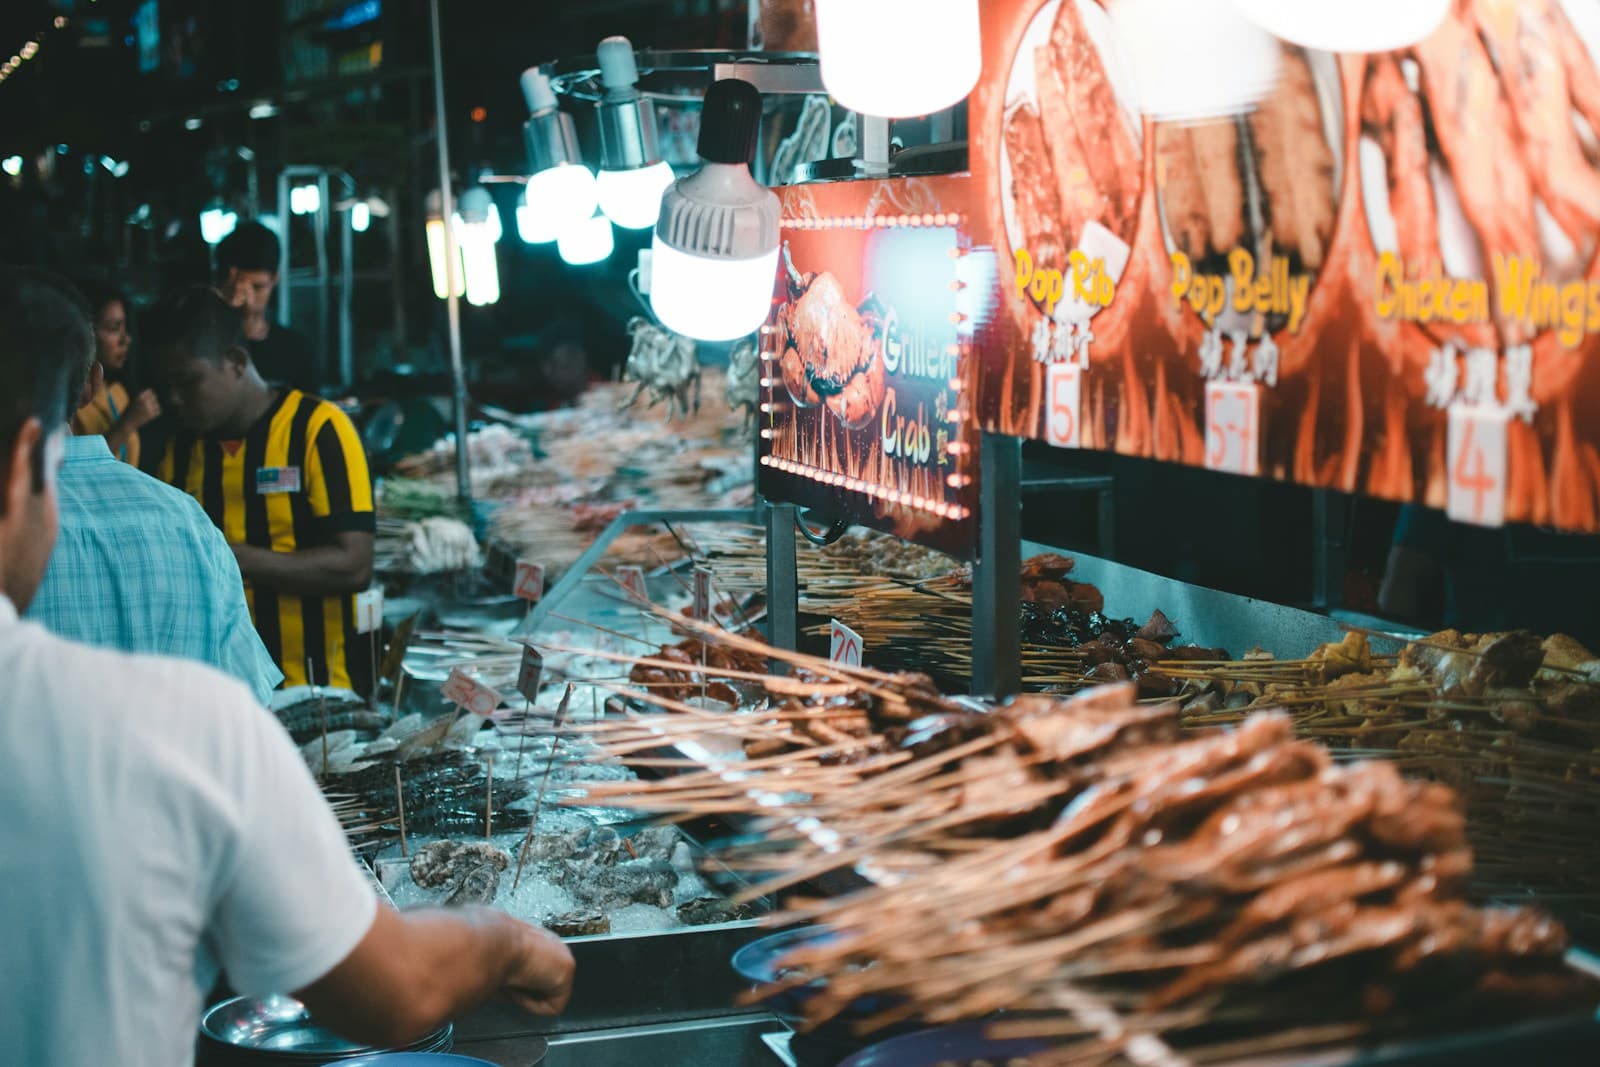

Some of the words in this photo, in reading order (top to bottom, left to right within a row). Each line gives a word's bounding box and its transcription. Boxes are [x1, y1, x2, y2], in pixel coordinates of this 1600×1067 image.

[1014, 248, 1063, 315] Pop
[1069, 249, 1115, 307] Rib
[1170, 251, 1225, 328] Pop
[1228, 247, 1309, 334] Belly
[1376, 250, 1490, 325] Chicken
[882, 387, 931, 465] Crab
[1051, 372, 1075, 445] 5
[1453, 418, 1496, 523] 4
